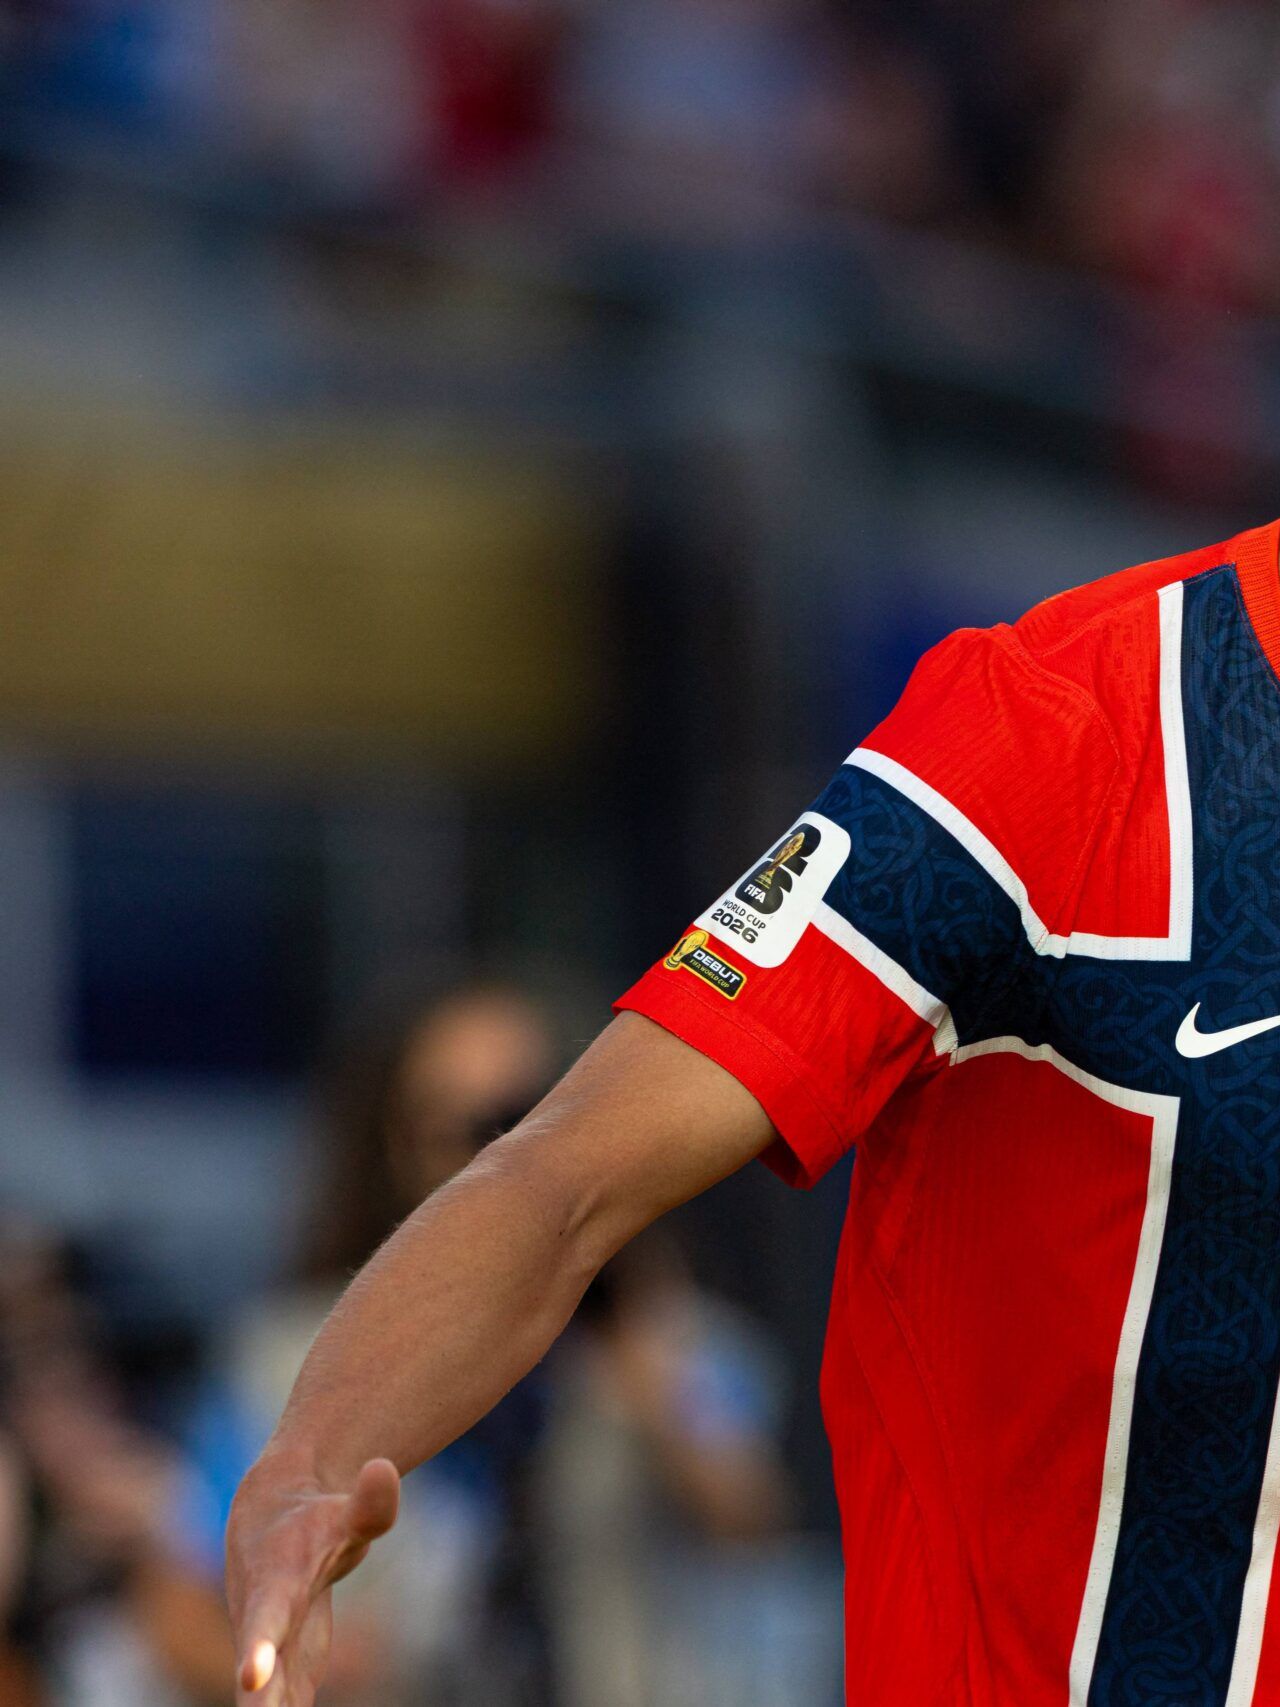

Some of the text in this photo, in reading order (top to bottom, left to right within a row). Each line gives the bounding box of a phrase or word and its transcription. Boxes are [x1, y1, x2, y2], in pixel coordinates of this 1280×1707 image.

[744, 884, 766, 903] FIFA
[711, 908, 759, 944] 2026
[722, 899, 767, 929] WORLD CUP
[692, 949, 741, 984] DEBUT
[700, 965, 719, 981] WORLD
